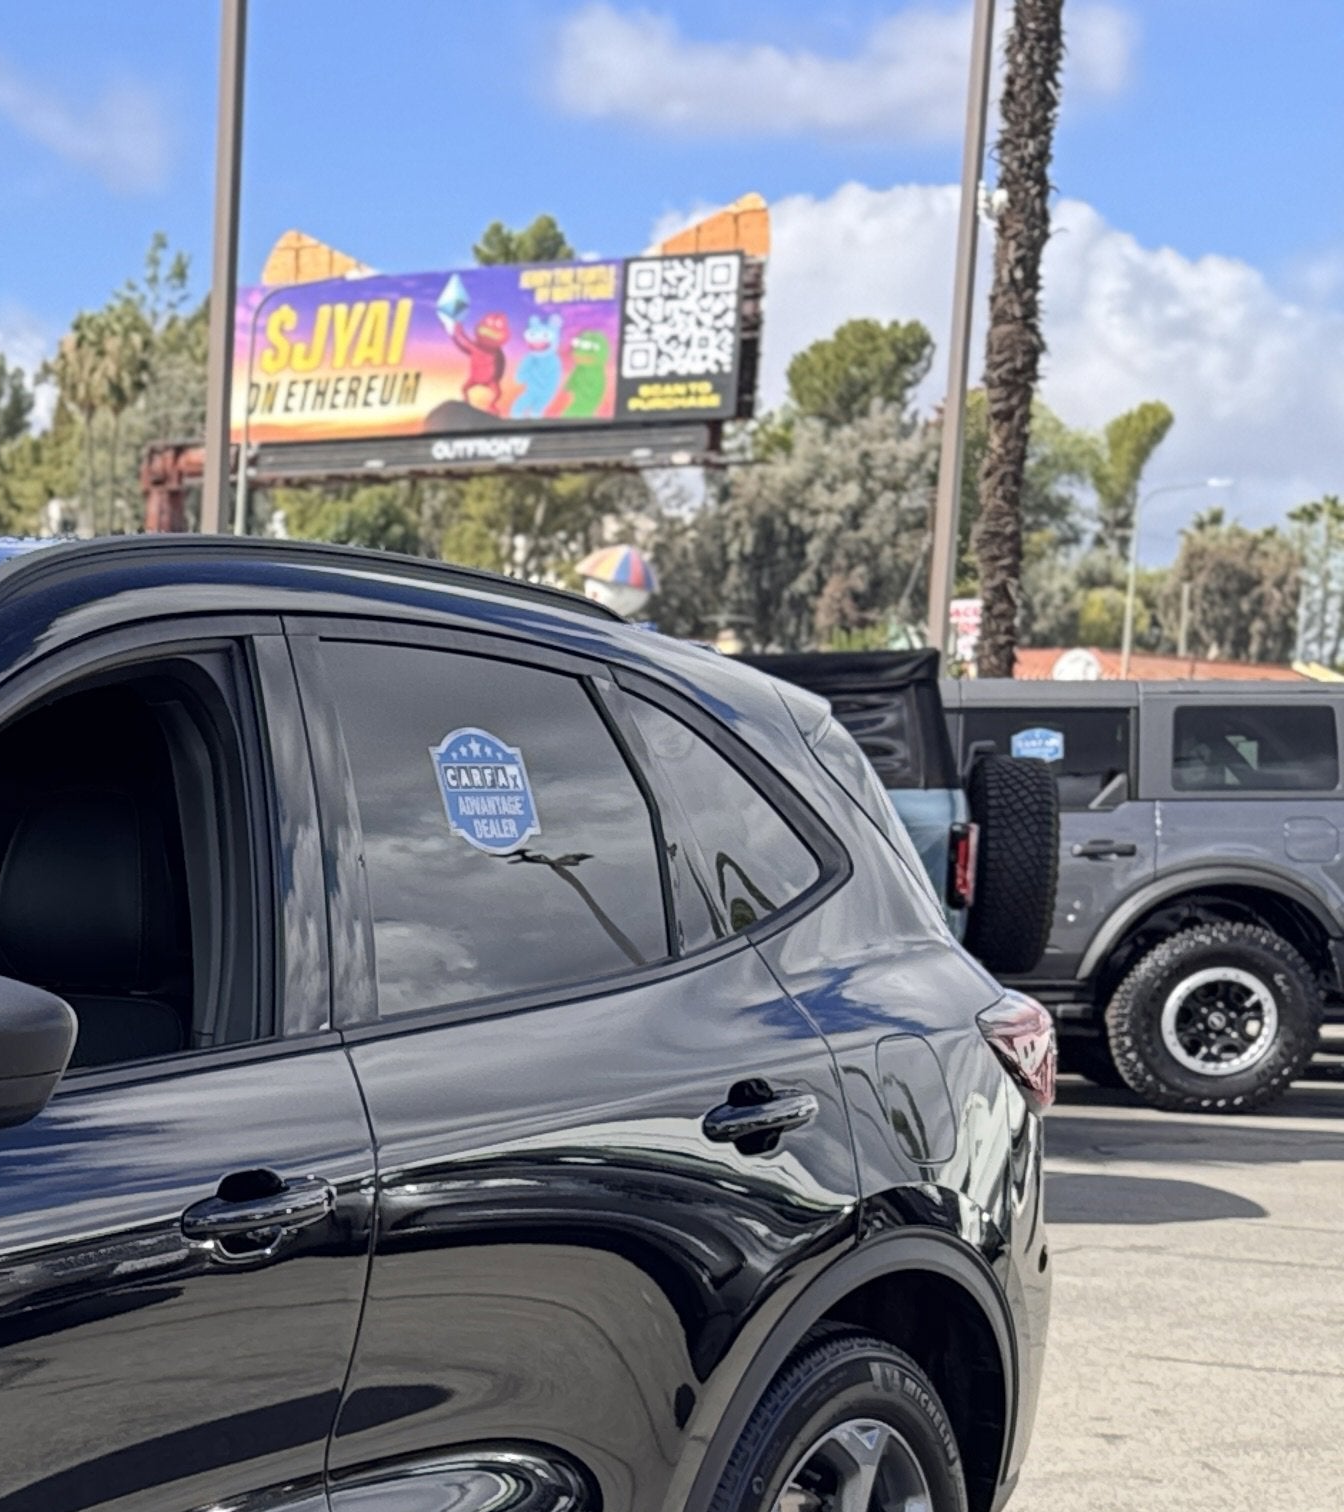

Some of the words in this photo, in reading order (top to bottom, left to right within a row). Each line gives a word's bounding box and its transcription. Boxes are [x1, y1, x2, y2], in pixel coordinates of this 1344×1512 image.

[259, 297, 413, 374] $JYAI
[282, 371, 422, 413] ETHEREUM
[444, 765, 524, 790] CARFAX
[457, 795, 525, 816] ADVANTAGE
[473, 818, 519, 839] DEALER
[902, 1377, 957, 1462] MICHELIN
